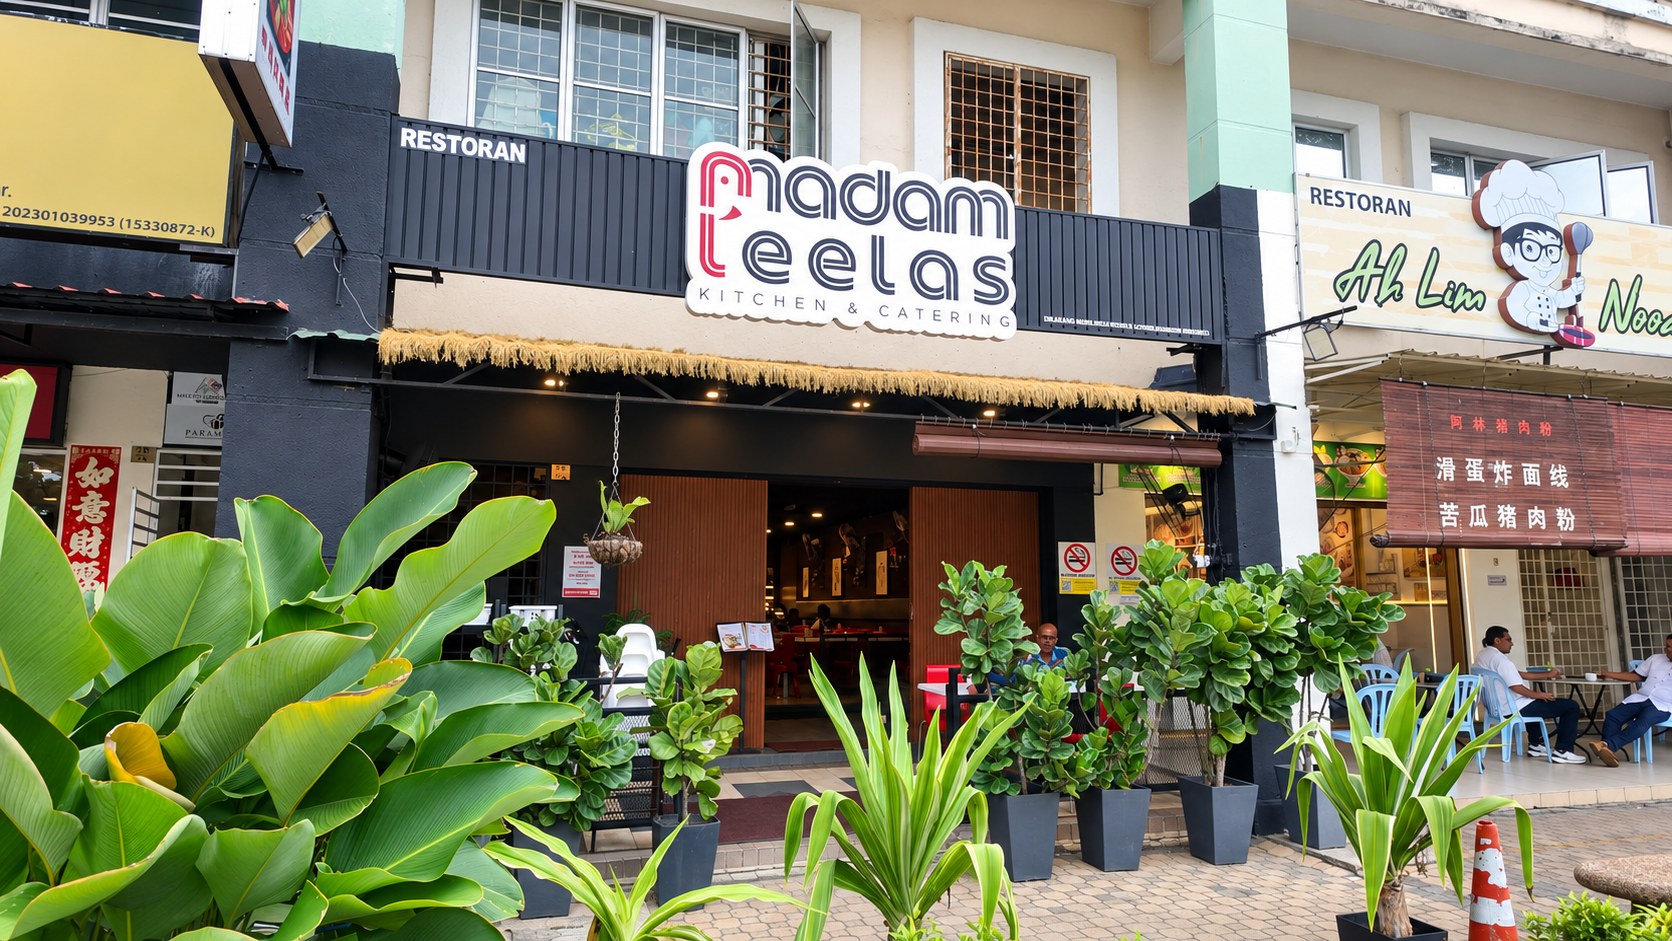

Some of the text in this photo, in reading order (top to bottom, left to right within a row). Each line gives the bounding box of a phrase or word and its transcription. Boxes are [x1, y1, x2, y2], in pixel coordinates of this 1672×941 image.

[400, 127, 526, 163] RESTORAN
[1310, 186, 1411, 217] RESTORAN
[2, 206, 215, 238] 202301039953 (15330872-K)
[1333, 239, 1409, 307] Ah
[1415, 246, 1487, 313] Lim
[699, 287, 1011, 328] KITCHEN & CATERING
[1436, 456, 1570, 489] 滑蛋炸面线
[1439, 502, 1576, 532] 苦瓜猪肉粉
